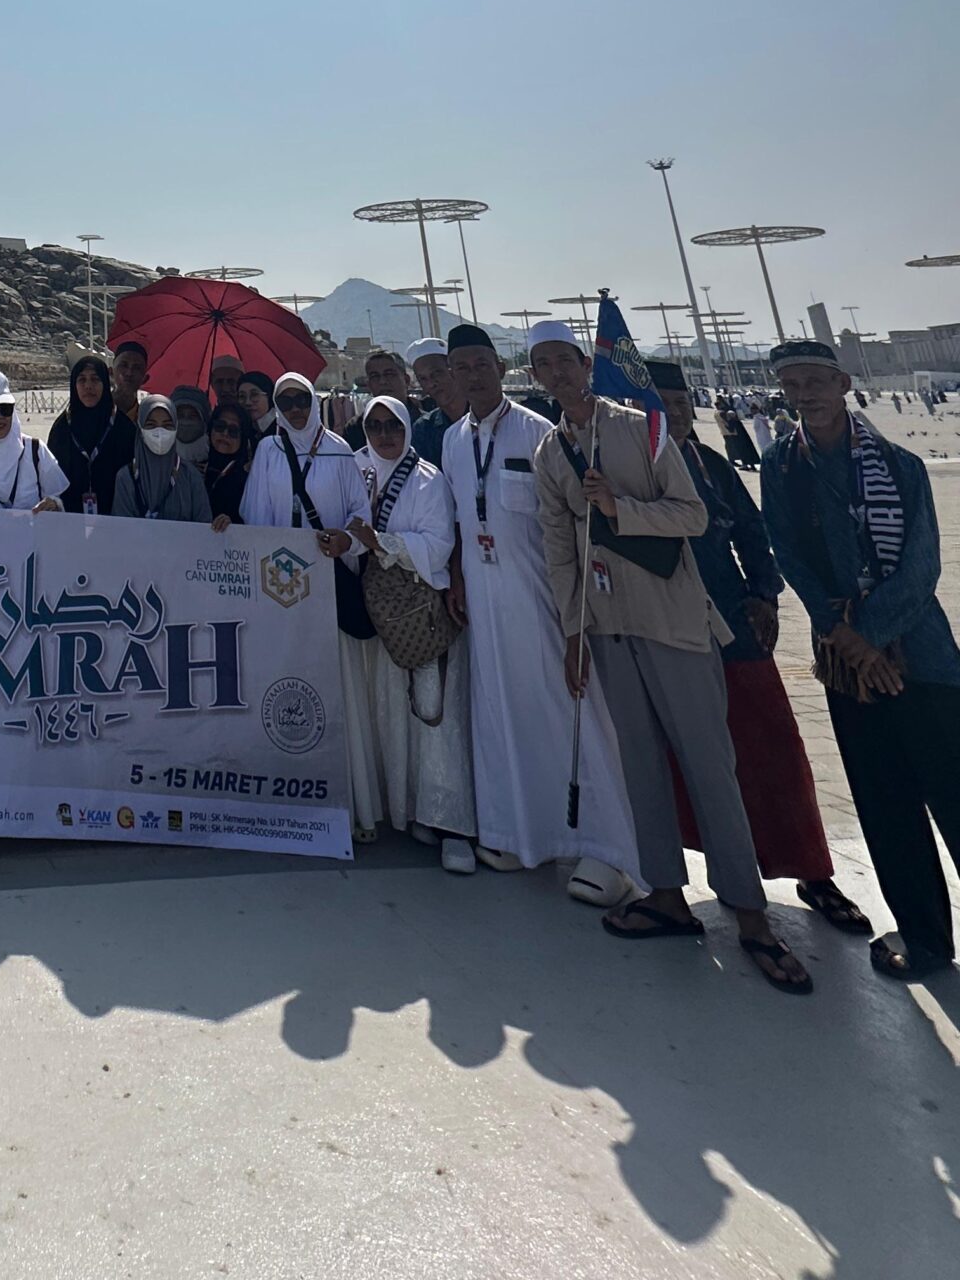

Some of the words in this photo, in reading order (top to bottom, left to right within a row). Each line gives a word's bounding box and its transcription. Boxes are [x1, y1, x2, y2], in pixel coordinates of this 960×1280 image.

[224, 549, 250, 561] NOW
[196, 559, 250, 574] EVERYONE
[185, 570, 207, 582] CAN
[208, 573, 251, 585] UMRAH
[218, 585, 227, 596] &
[130, 764, 144, 785] 5
[163, 767, 187, 789] 15
[192, 770, 269, 796] MARET
[272, 777, 329, 800] 2025
[87, 809, 112, 823] KAN
[309, 821, 326, 831] 2021
